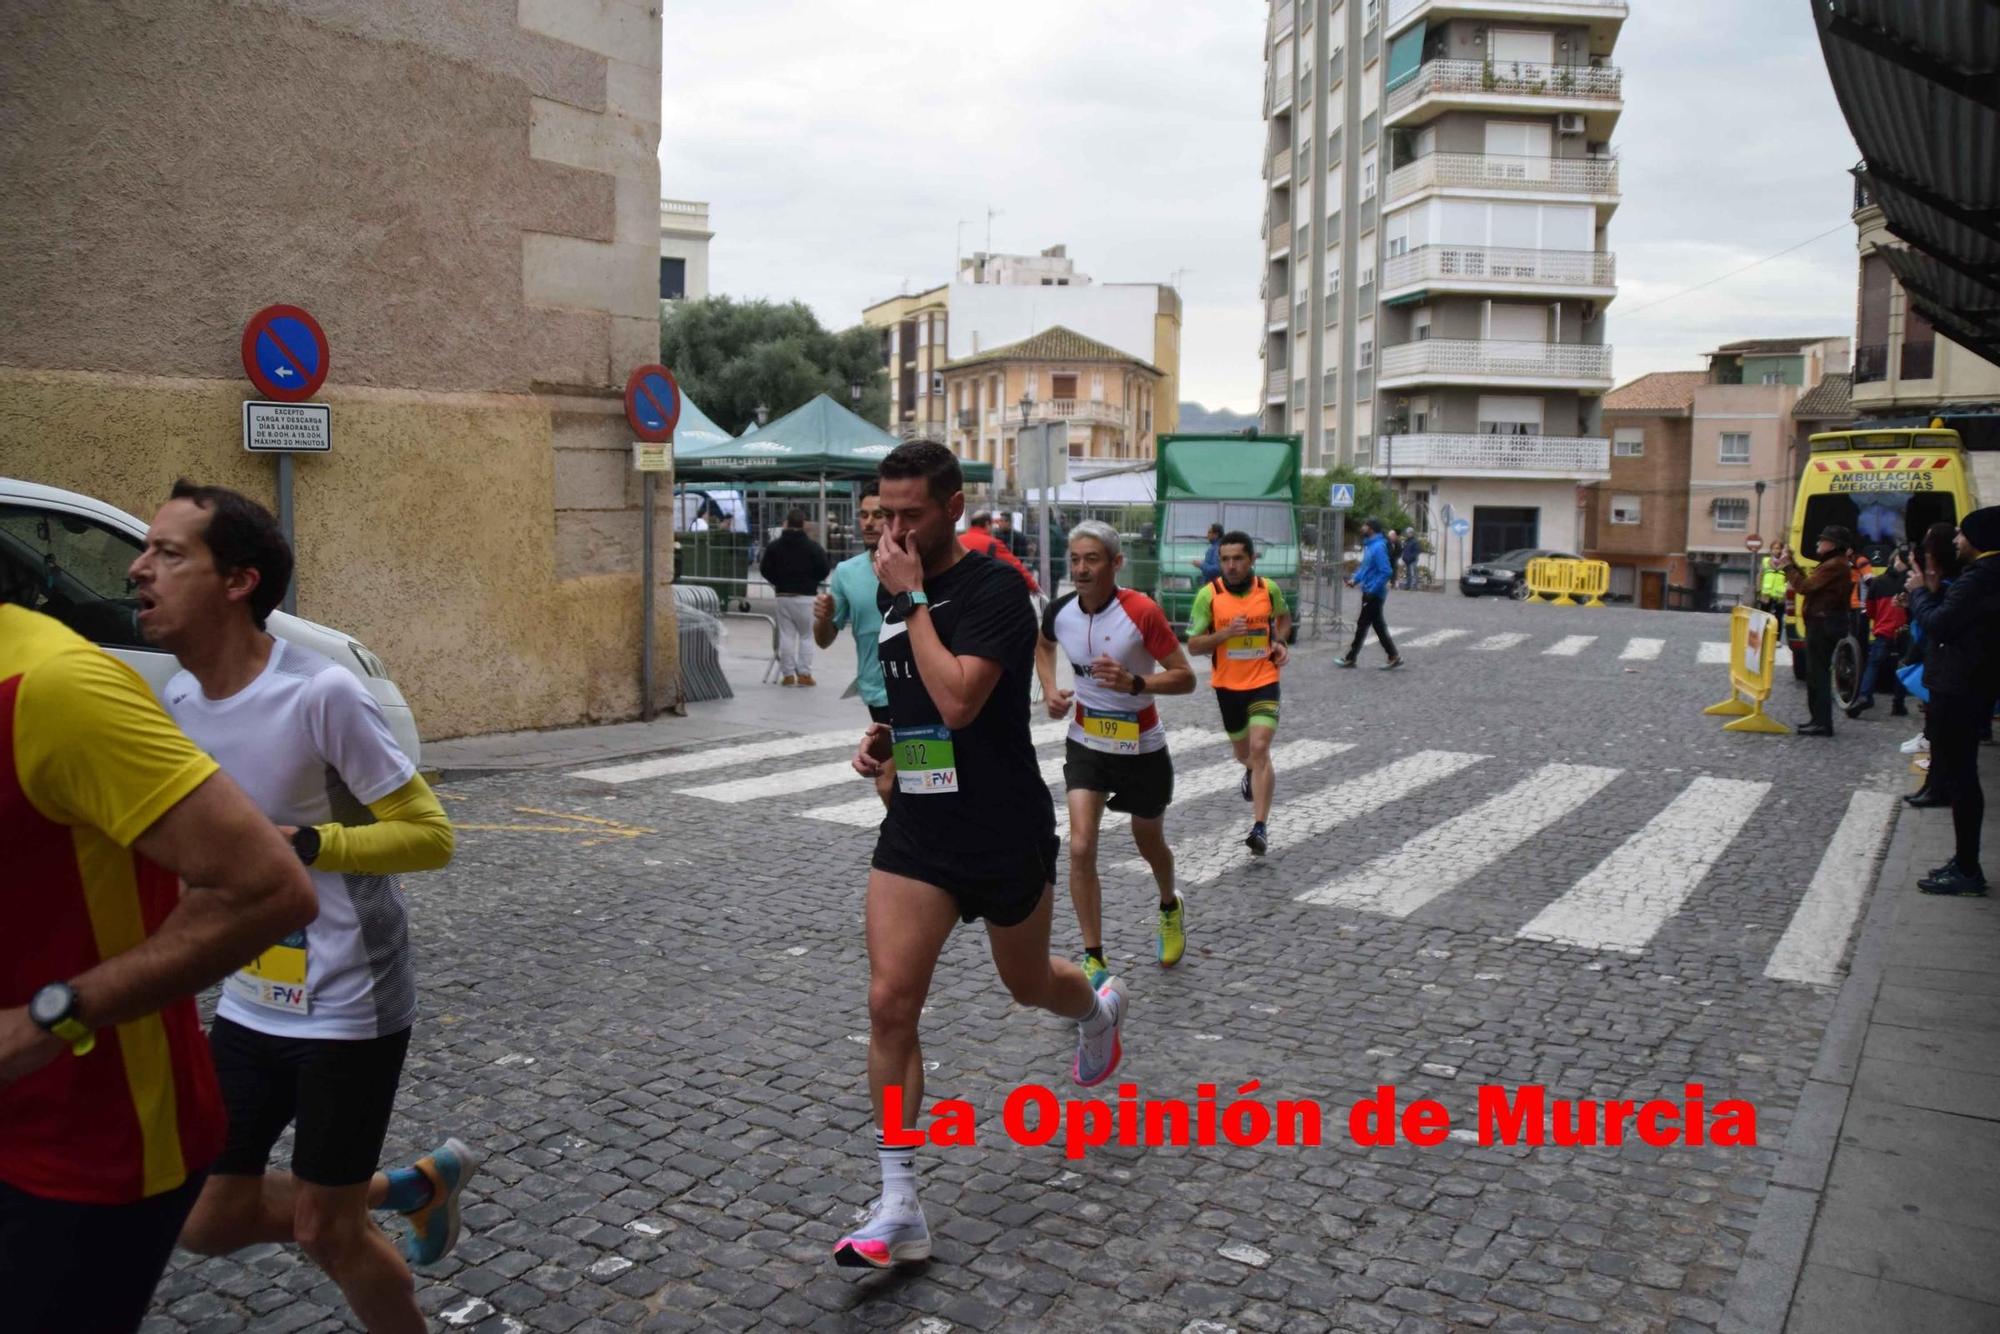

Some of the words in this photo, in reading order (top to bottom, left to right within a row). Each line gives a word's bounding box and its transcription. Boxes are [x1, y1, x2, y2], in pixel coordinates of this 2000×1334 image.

[274, 408, 305, 416] EXCEPTO
[286, 416, 322, 424] DESCARGA
[294, 439, 325, 447] MINUTOS
[1829, 481, 1934, 492] EMERGENCIAS
[1100, 720, 1118, 735] 199
